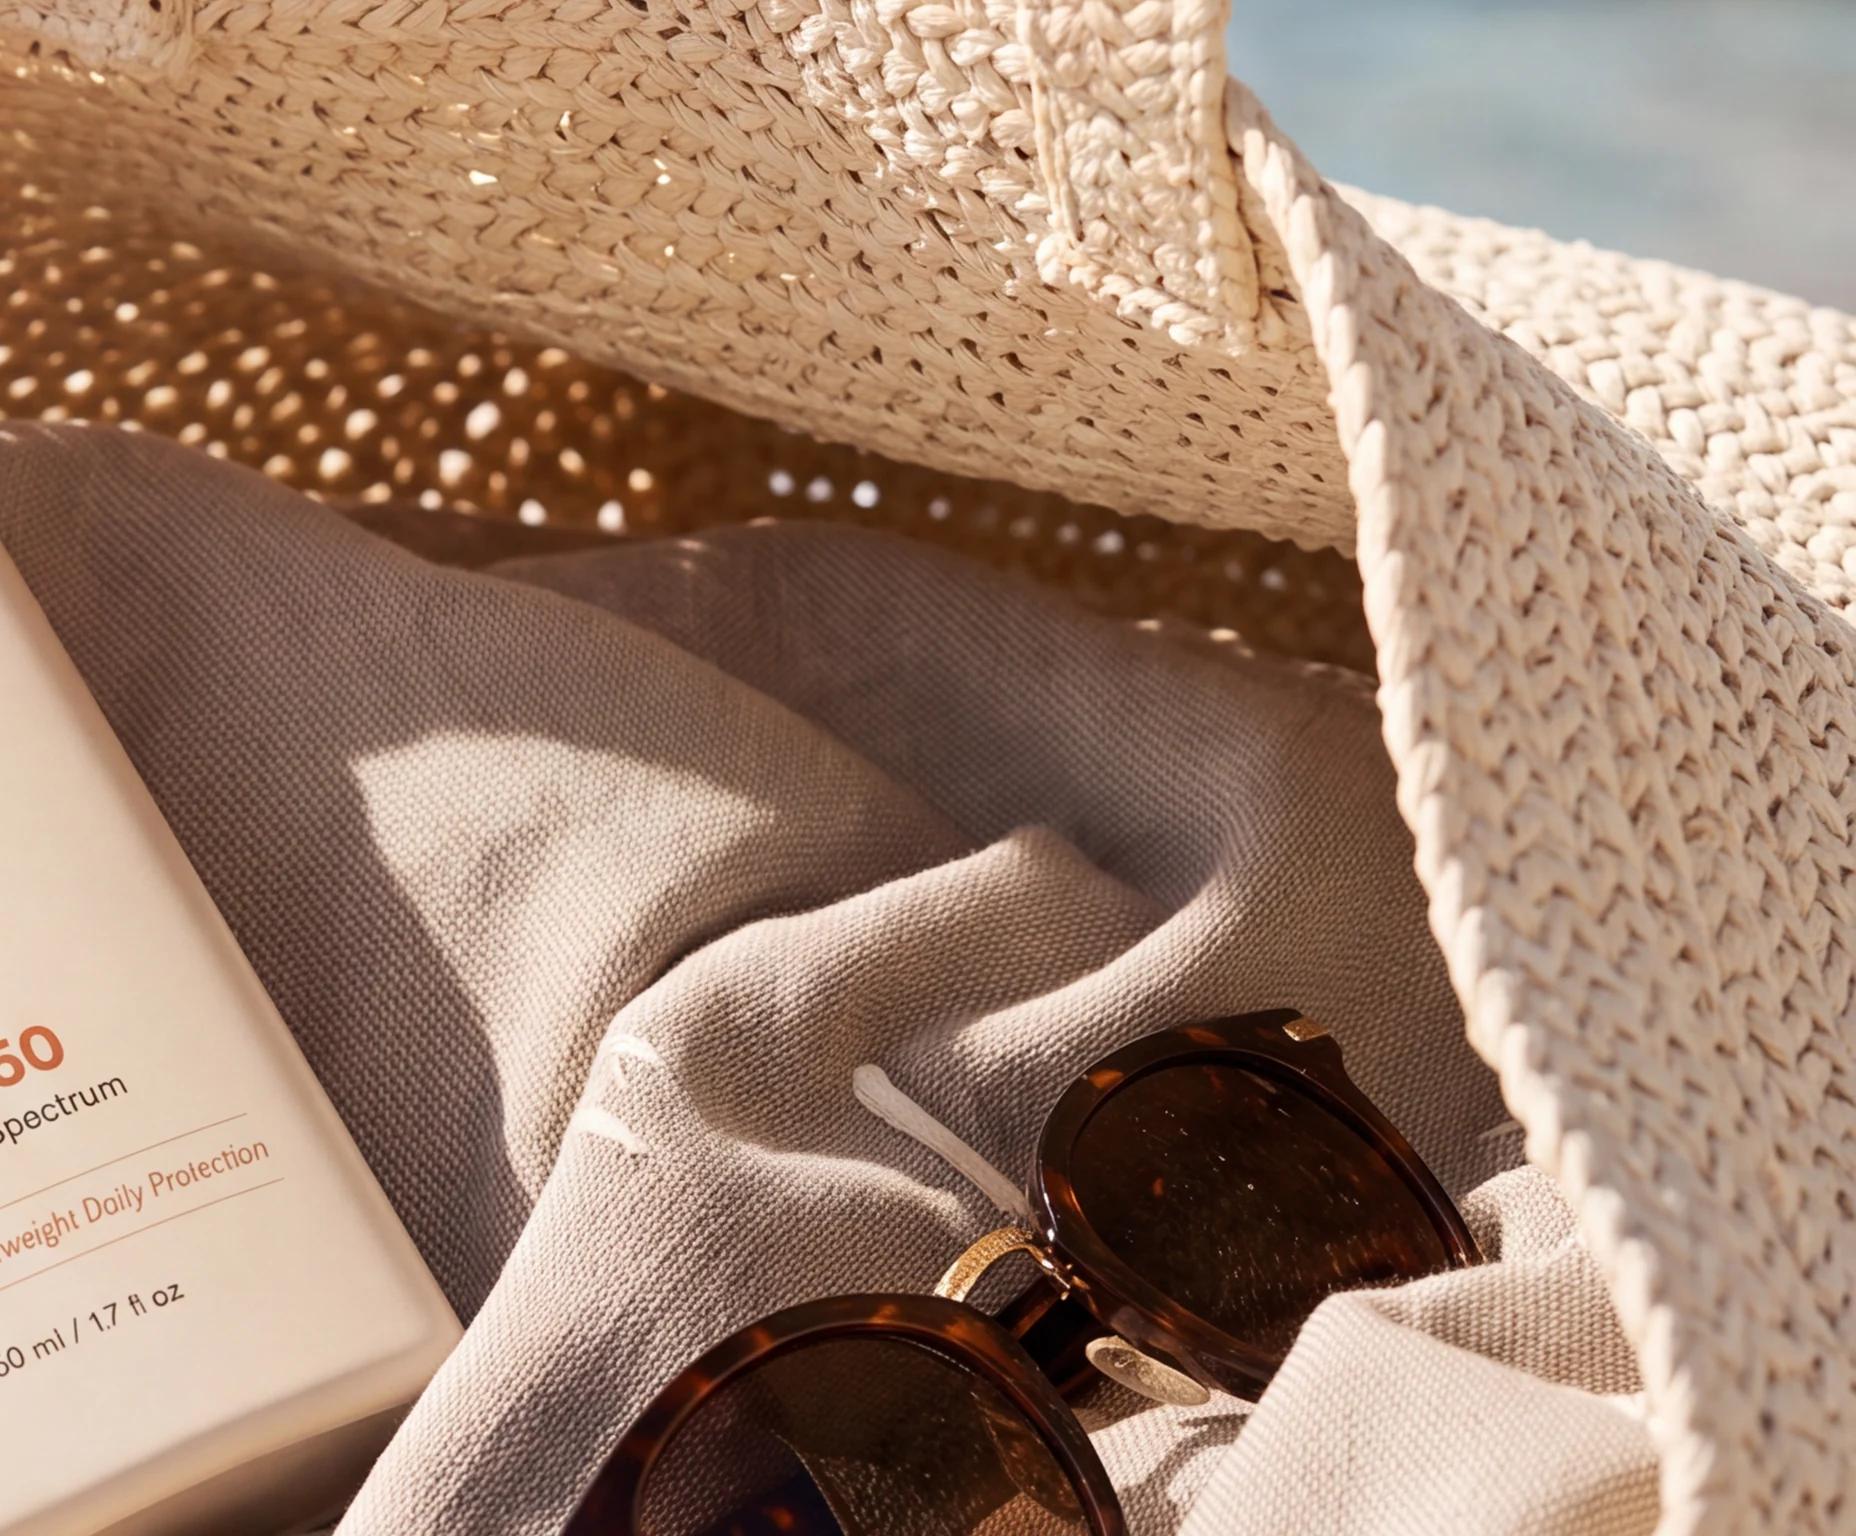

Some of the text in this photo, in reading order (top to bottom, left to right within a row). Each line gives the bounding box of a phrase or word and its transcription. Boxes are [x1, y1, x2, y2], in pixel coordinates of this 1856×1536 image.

[81, 1183, 143, 1224] Daily
[147, 1142, 270, 1198] Protection
[31, 1327, 67, 1360] ml
[72, 1317, 80, 1345] /
[88, 1301, 118, 1333] 1.7
[127, 1293, 148, 1317] fl
[151, 1283, 186, 1308] oz
